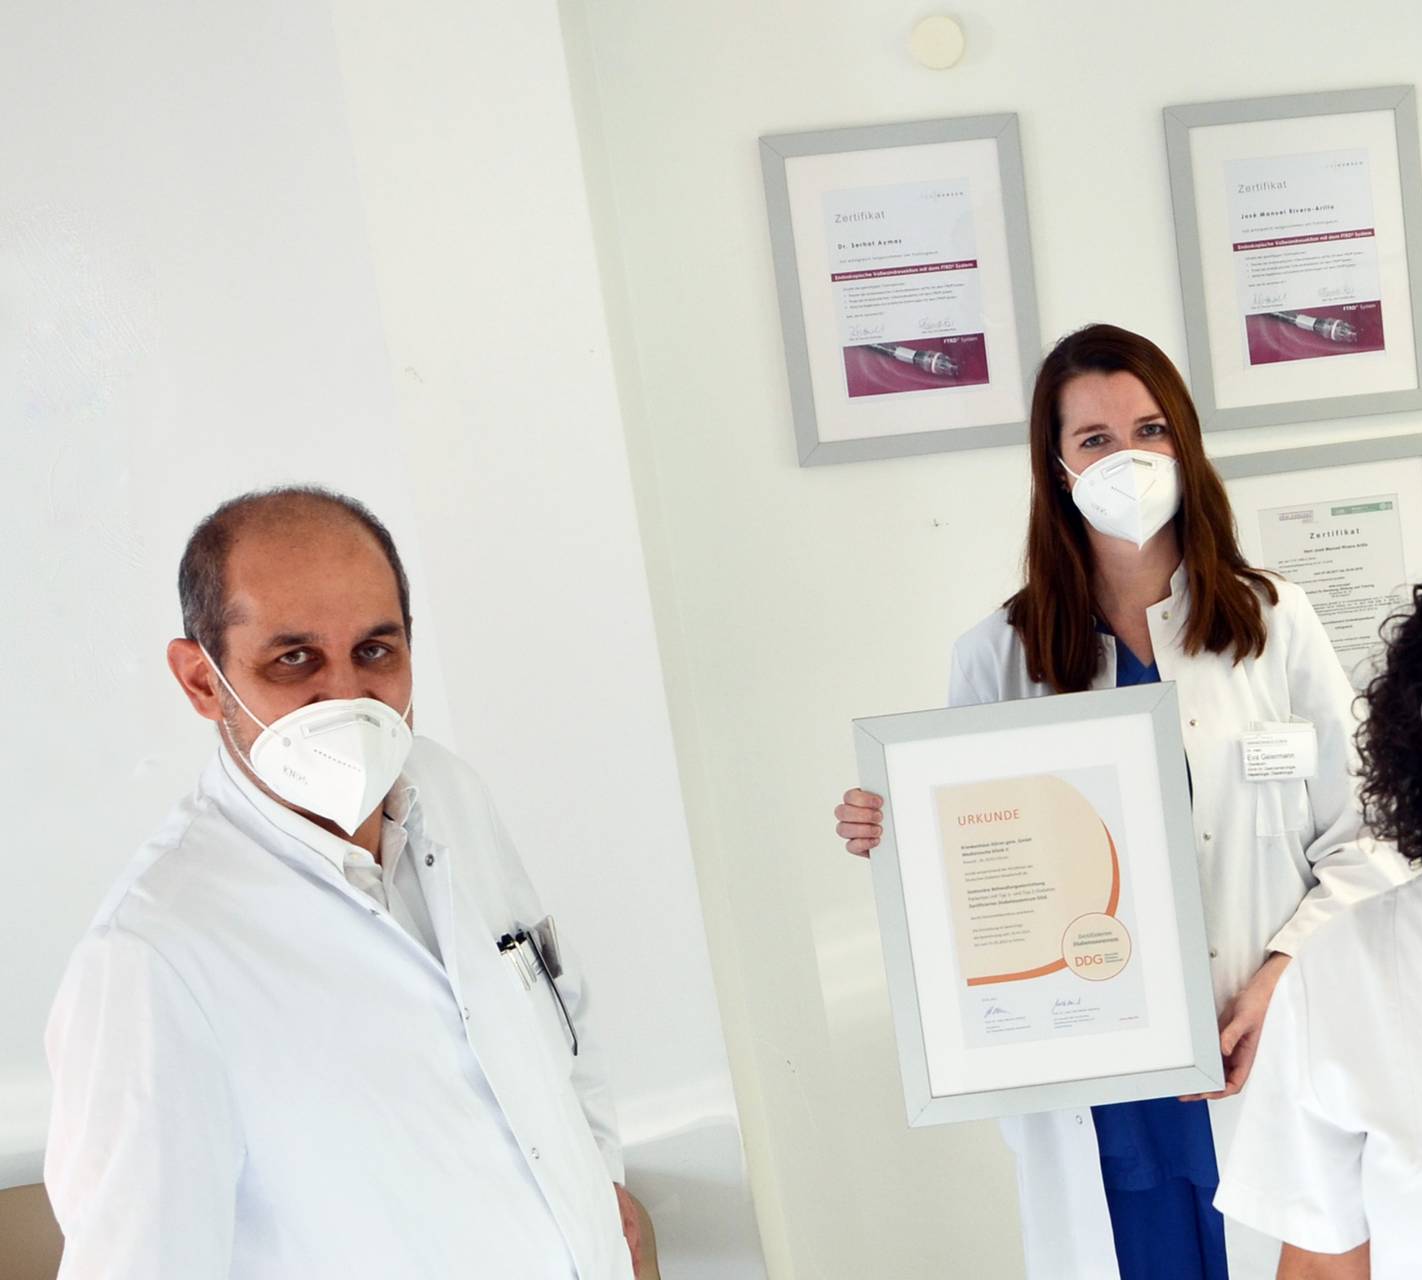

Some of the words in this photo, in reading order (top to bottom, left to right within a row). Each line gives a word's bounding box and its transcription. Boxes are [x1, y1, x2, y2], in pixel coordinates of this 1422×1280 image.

[1237, 180, 1288, 194] Zertifikat
[834, 210, 886, 225] Zertifikat
[1309, 528, 1361, 541] Zertifikat
[957, 808, 1020, 826] URKUNDE
[1074, 953, 1103, 968] DDG
